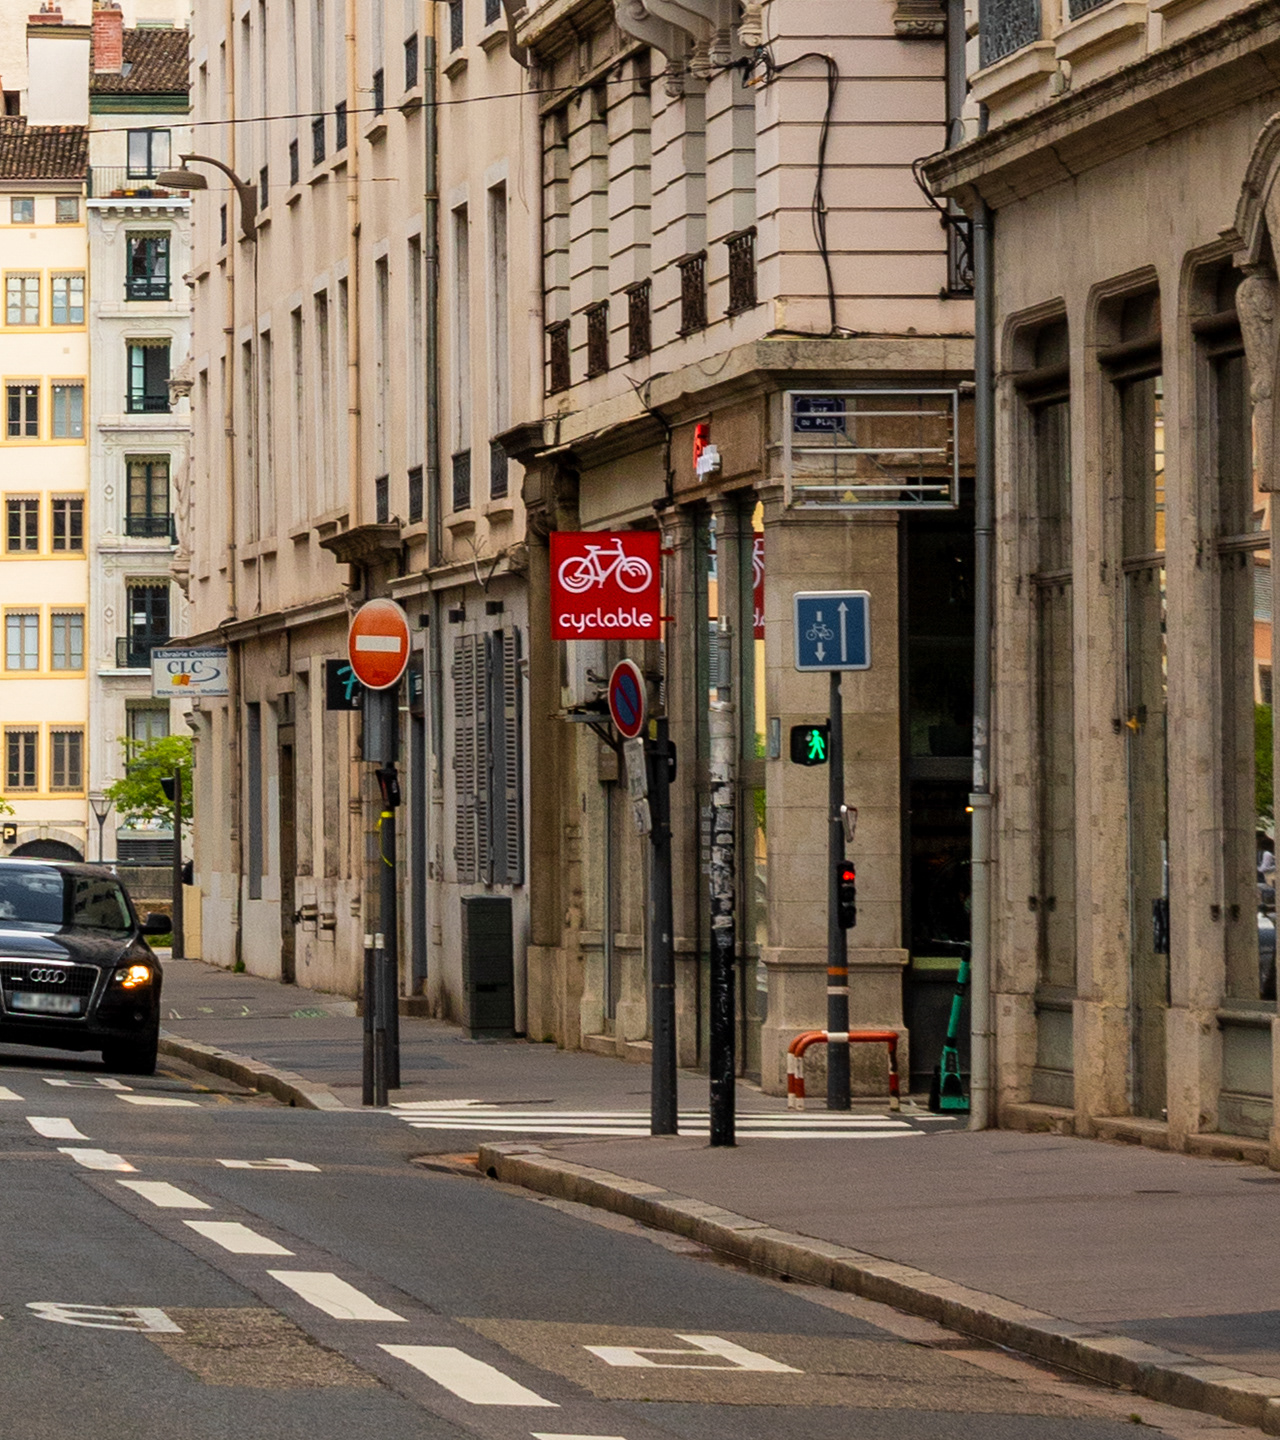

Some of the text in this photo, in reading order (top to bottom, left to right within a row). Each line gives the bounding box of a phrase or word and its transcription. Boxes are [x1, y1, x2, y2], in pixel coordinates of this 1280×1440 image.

[559, 607, 653, 633] cyclable
[167, 660, 203, 673] CLC
[4, 828, 15, 840] P
